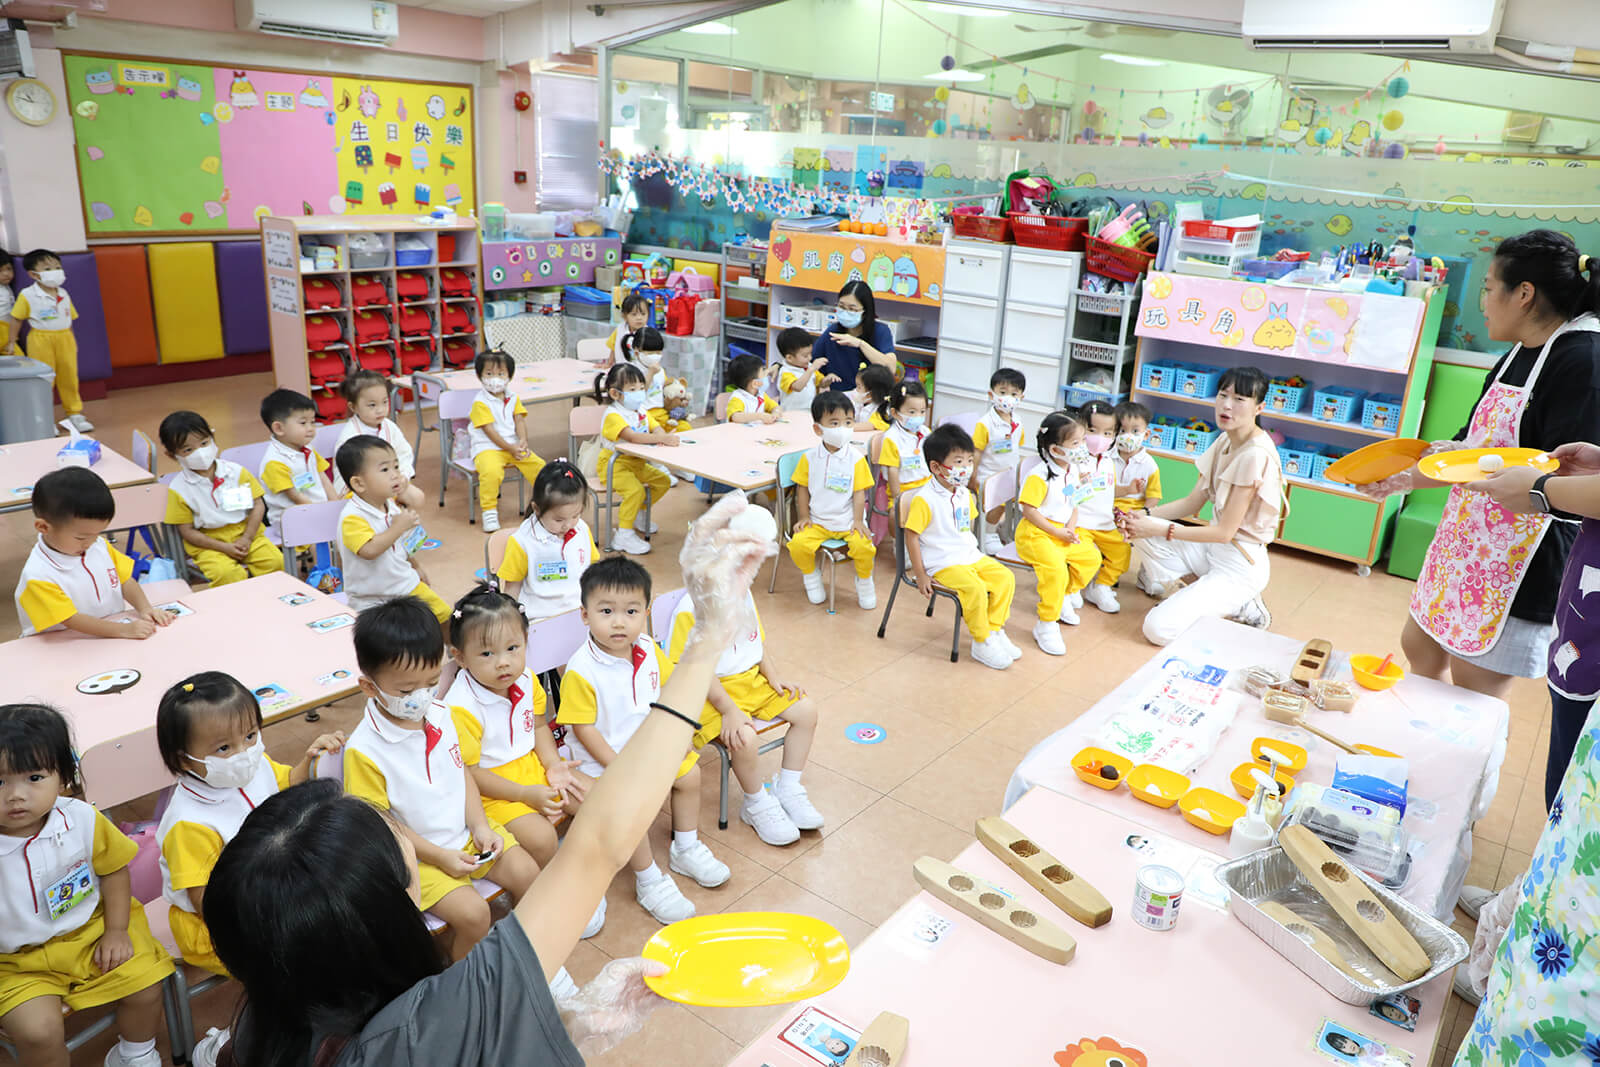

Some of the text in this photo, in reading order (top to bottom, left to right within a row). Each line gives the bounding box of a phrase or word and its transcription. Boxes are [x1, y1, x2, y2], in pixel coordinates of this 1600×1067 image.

[351, 120, 463, 145] 生日快樂
[1144, 300, 1234, 333] 玩具角
